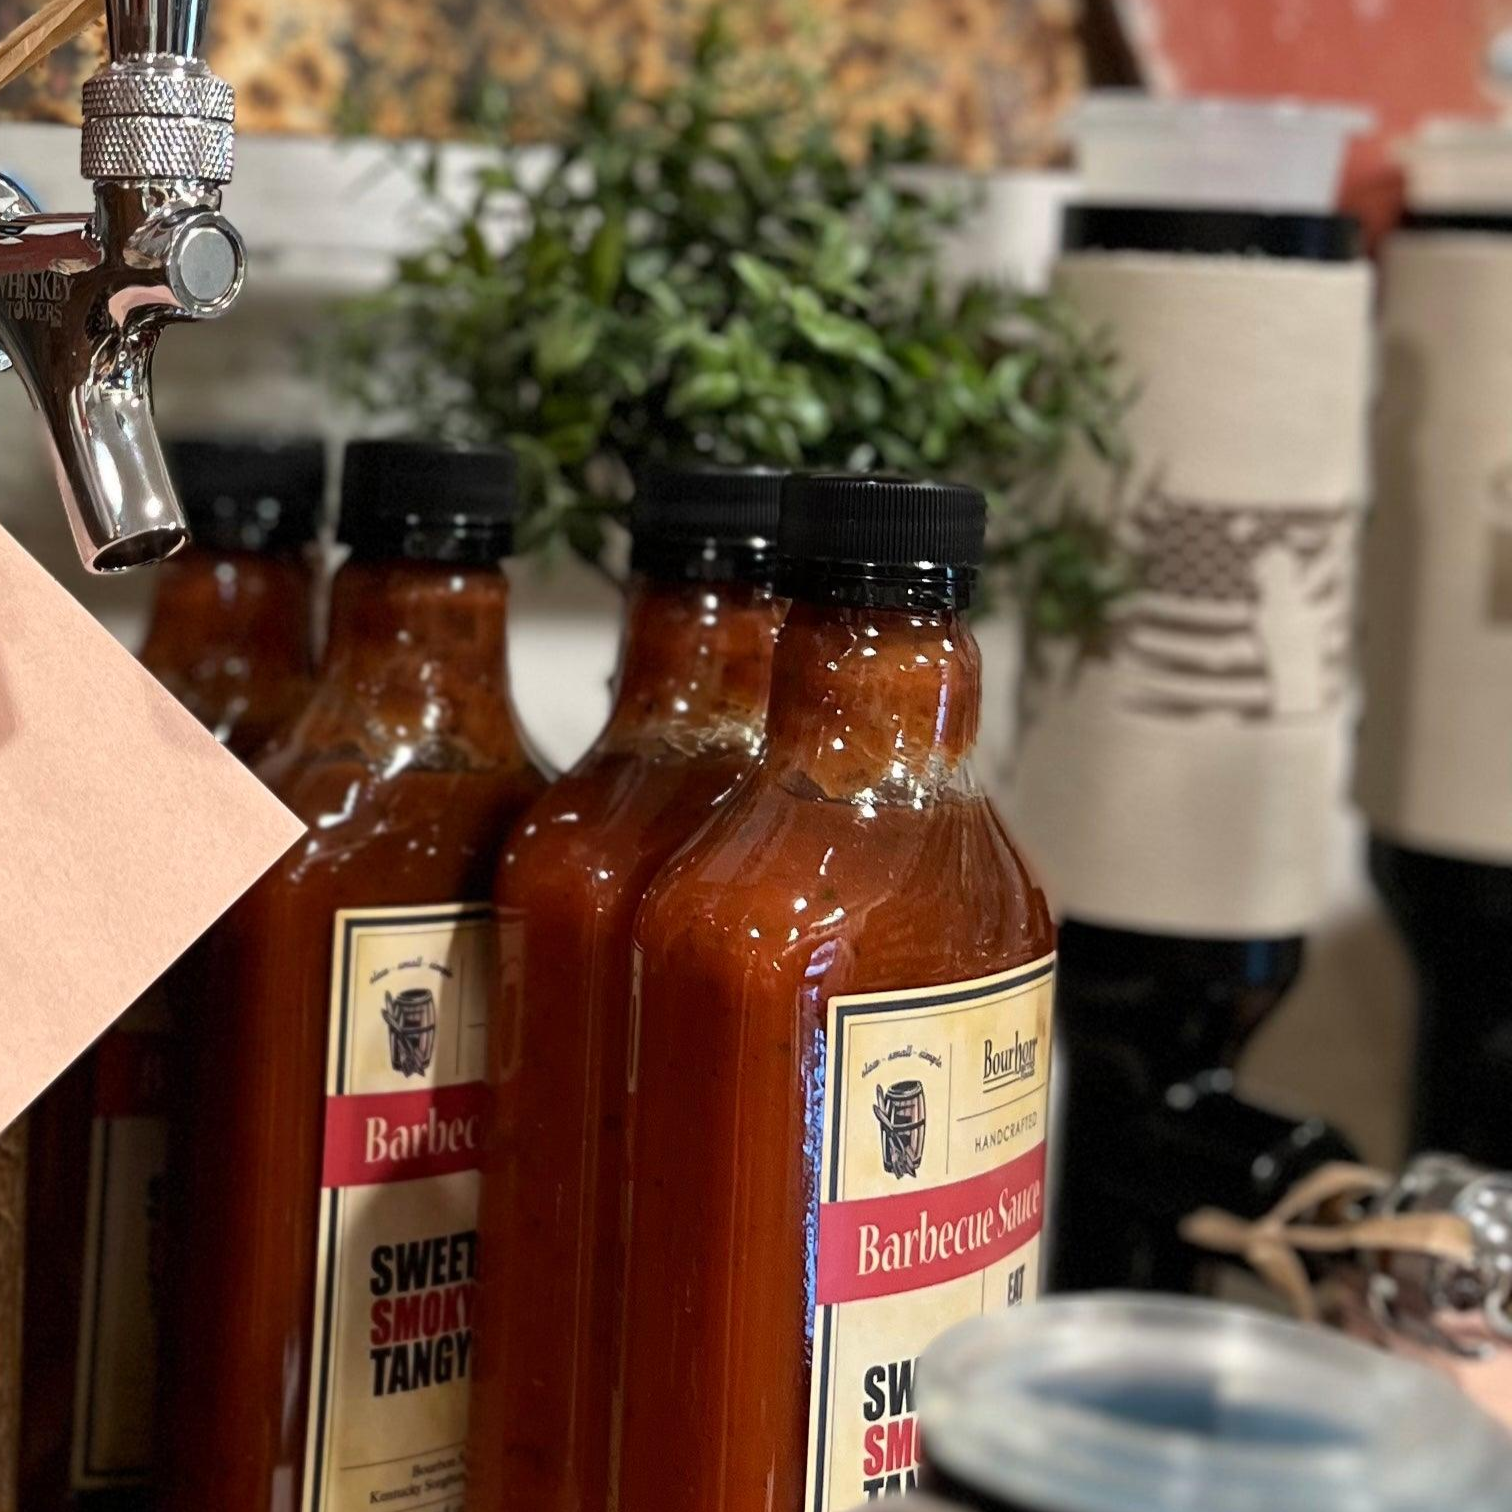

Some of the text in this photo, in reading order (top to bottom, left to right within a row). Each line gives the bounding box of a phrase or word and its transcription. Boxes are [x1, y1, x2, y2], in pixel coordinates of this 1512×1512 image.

[7, 298, 63, 328] TOWERS
[974, 1111, 1038, 1153] HANDCRAFTED
[856, 1179, 1042, 1276] Barbecue Sauce
[369, 1230, 478, 1297] SWEET
[369, 1328, 473, 1398] TANGY
